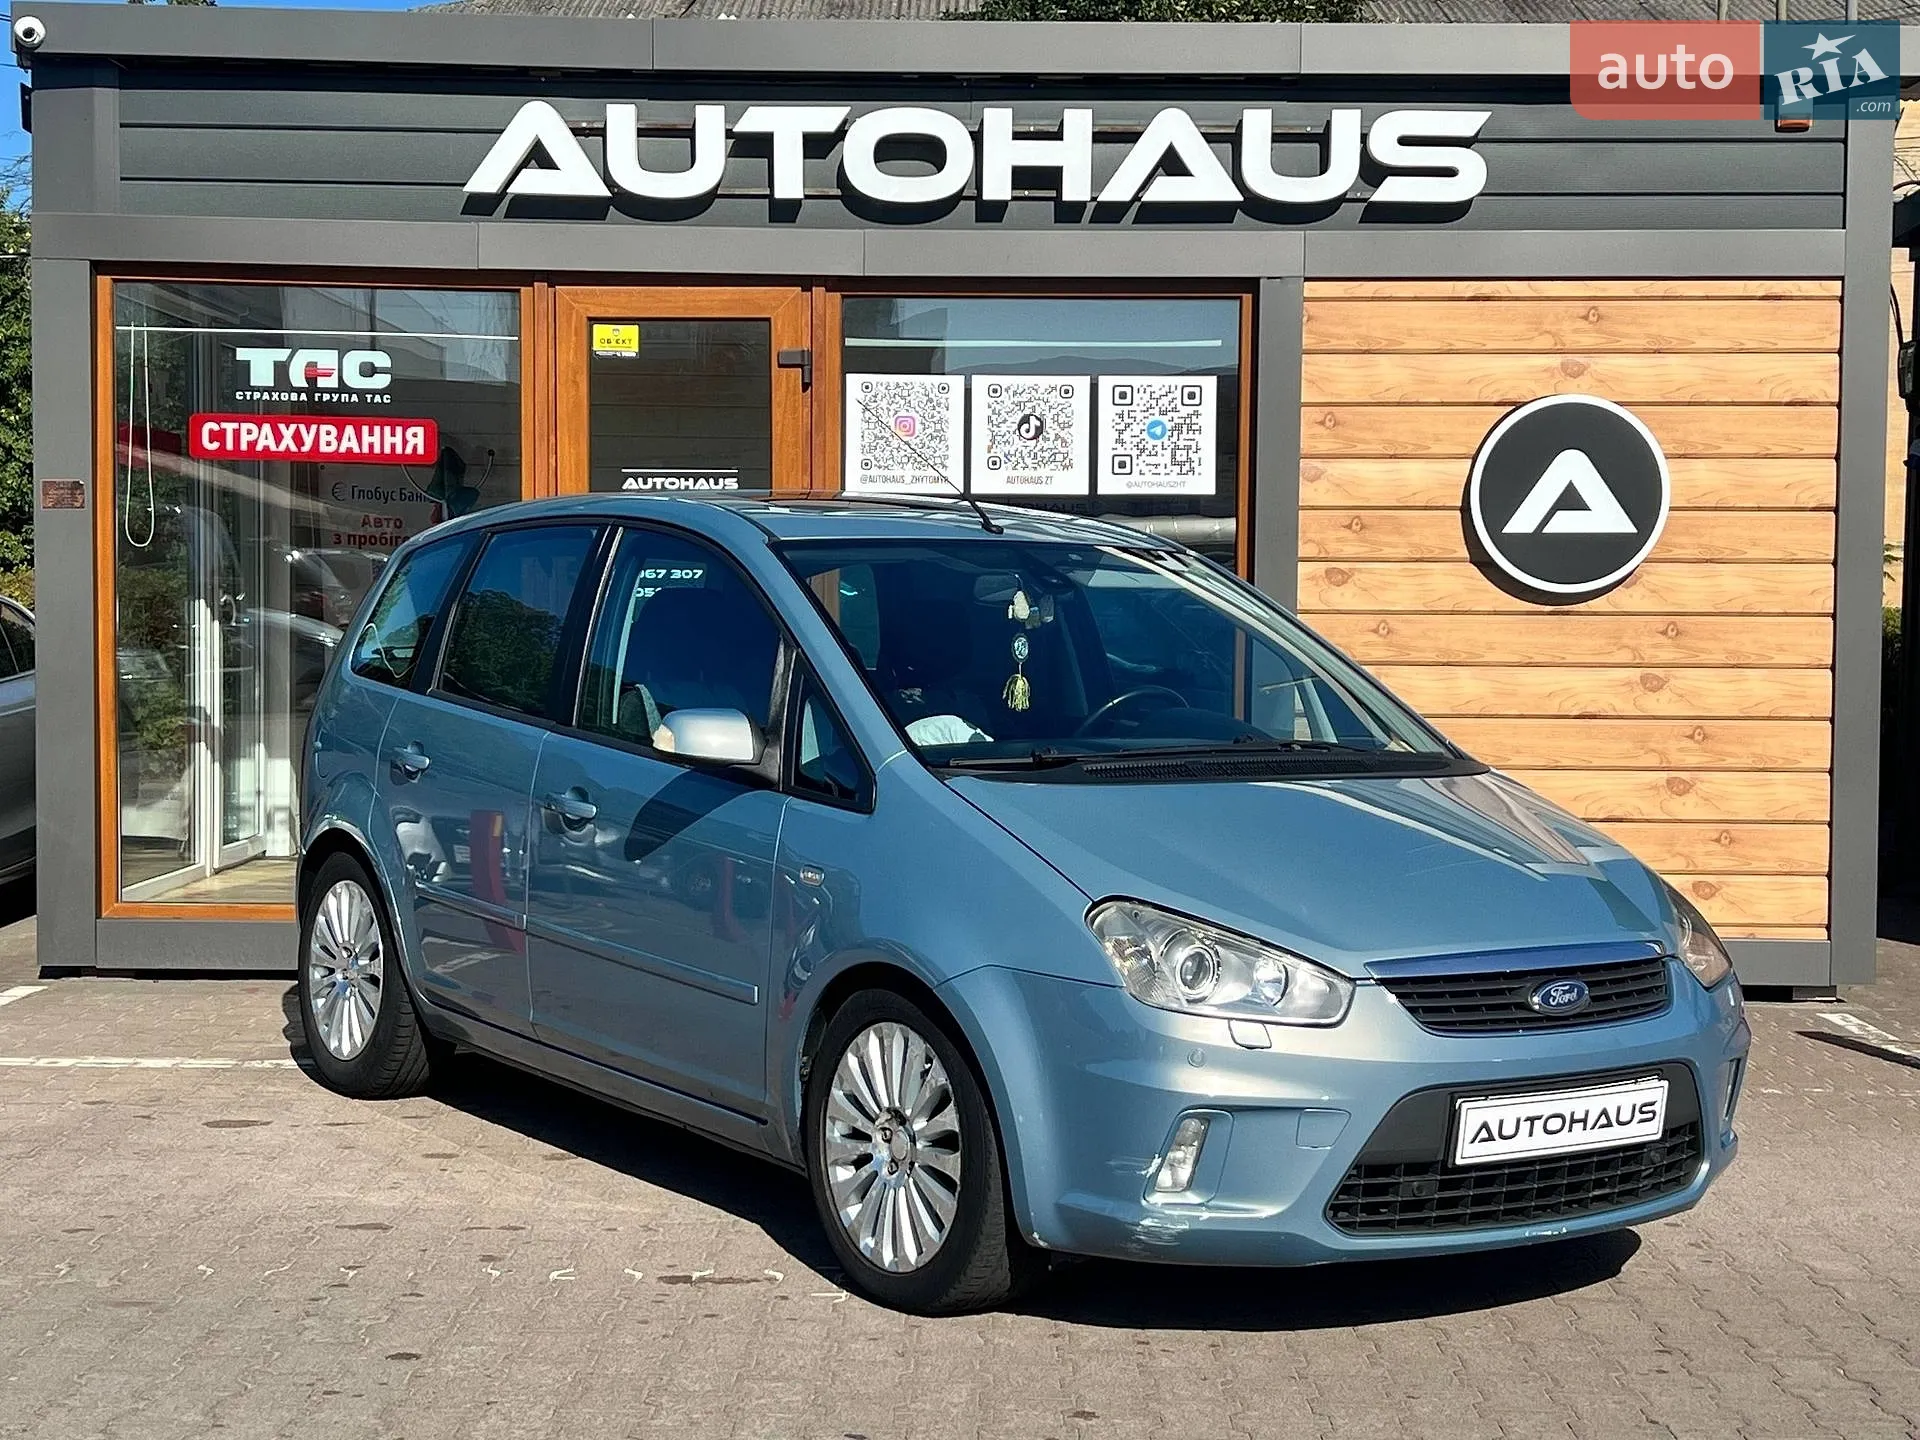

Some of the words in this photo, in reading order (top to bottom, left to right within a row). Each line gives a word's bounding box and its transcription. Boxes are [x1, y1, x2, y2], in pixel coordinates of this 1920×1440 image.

[462, 100, 1491, 203] AUTOHAUS
[235, 391, 308, 402] СТРАХОВА
[314, 392, 359, 403] ГРУПА
[366, 393, 391, 403] ТАС
[200, 420, 425, 456] СТРАХУВАННЯ
[621, 477, 739, 490] AUTOHAUS
[351, 485, 397, 504] Глобус
[361, 514, 403, 529] Авто
[670, 569, 703, 579] 307
[635, 587, 662, 597] 05
[1549, 985, 1578, 1006] Ford
[1469, 1100, 1658, 1144] AUTOHAUS
